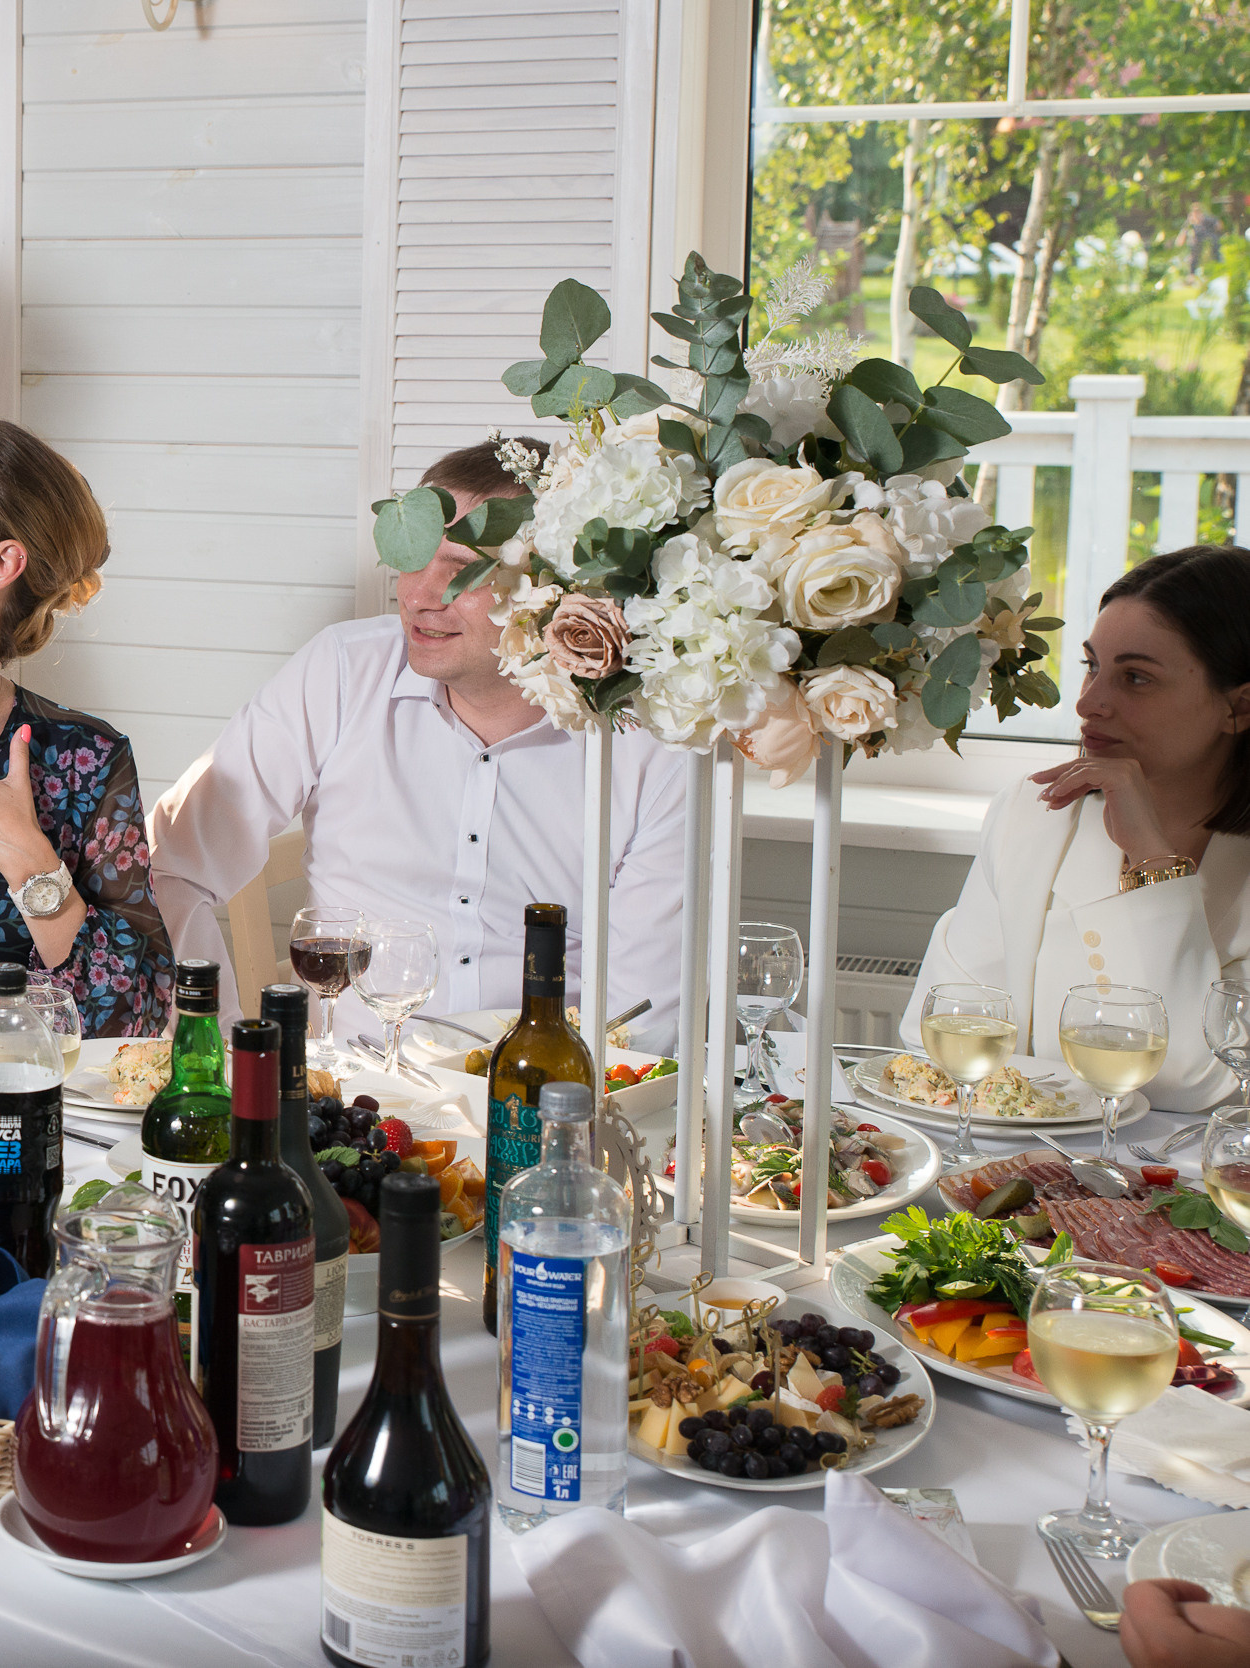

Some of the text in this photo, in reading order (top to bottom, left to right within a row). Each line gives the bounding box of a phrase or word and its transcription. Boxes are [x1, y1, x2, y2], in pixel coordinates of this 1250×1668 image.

[153, 1172, 204, 1204] FOX
[514, 1264, 536, 1277] YOUR
[547, 1271, 582, 1281] WATER
[352, 1531, 401, 1548] TORRES
